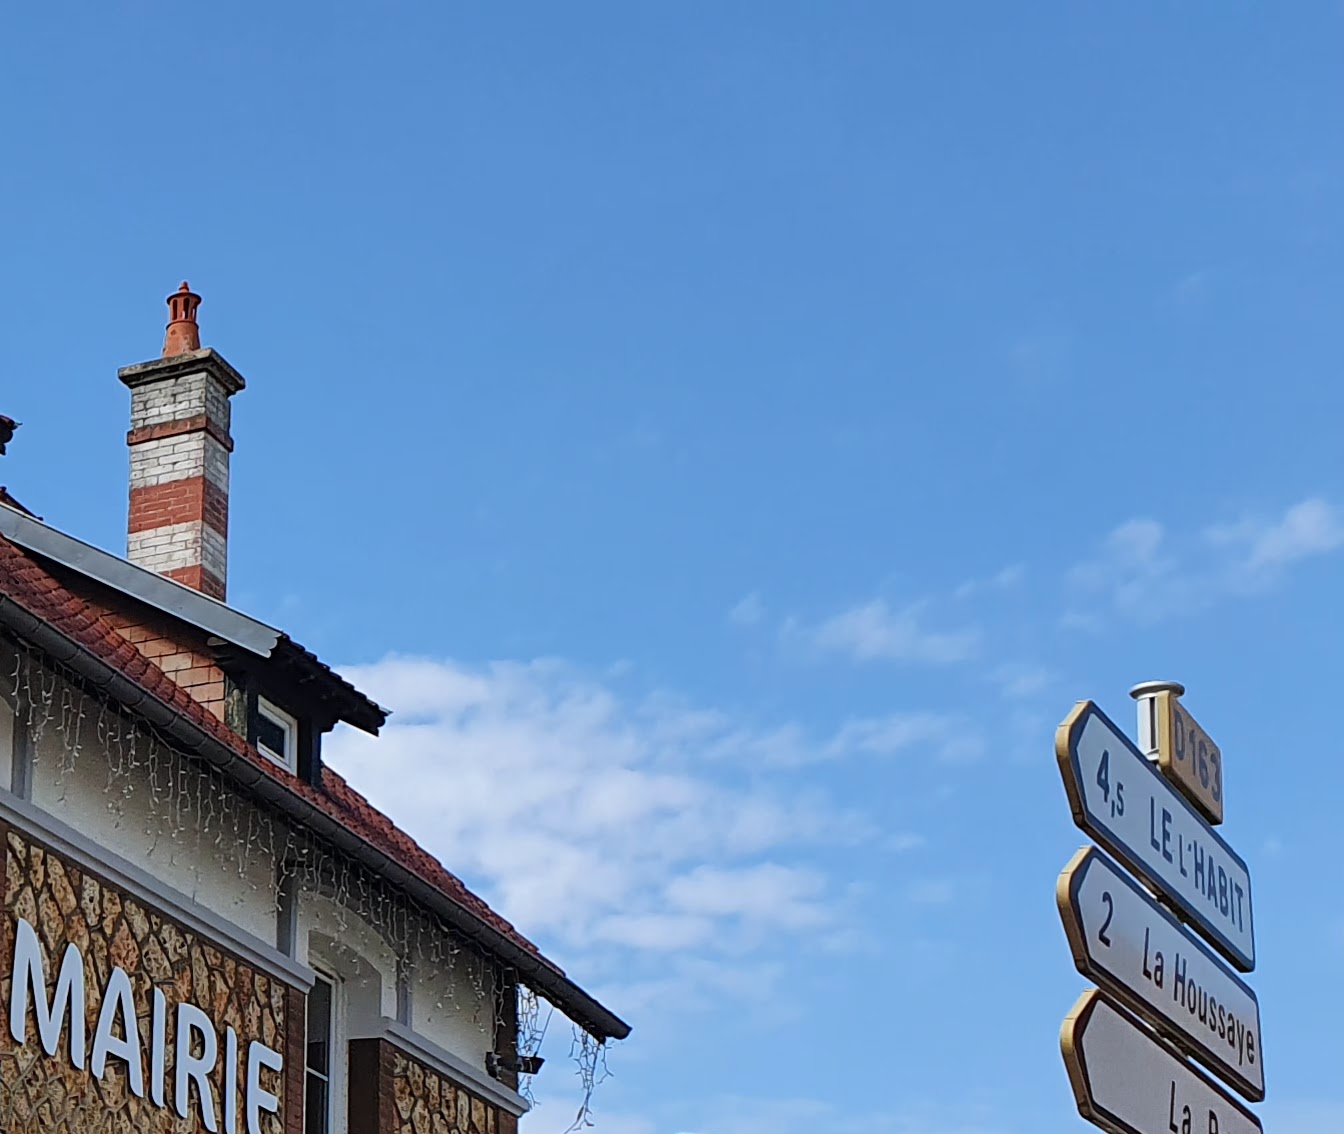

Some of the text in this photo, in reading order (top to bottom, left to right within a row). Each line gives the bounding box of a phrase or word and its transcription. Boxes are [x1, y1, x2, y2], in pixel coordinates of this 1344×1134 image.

[1150, 796, 1174, 864] LE
[1179, 833, 1244, 933] L'HABIT
[1098, 891, 1255, 1068] 2 La Houssaye
